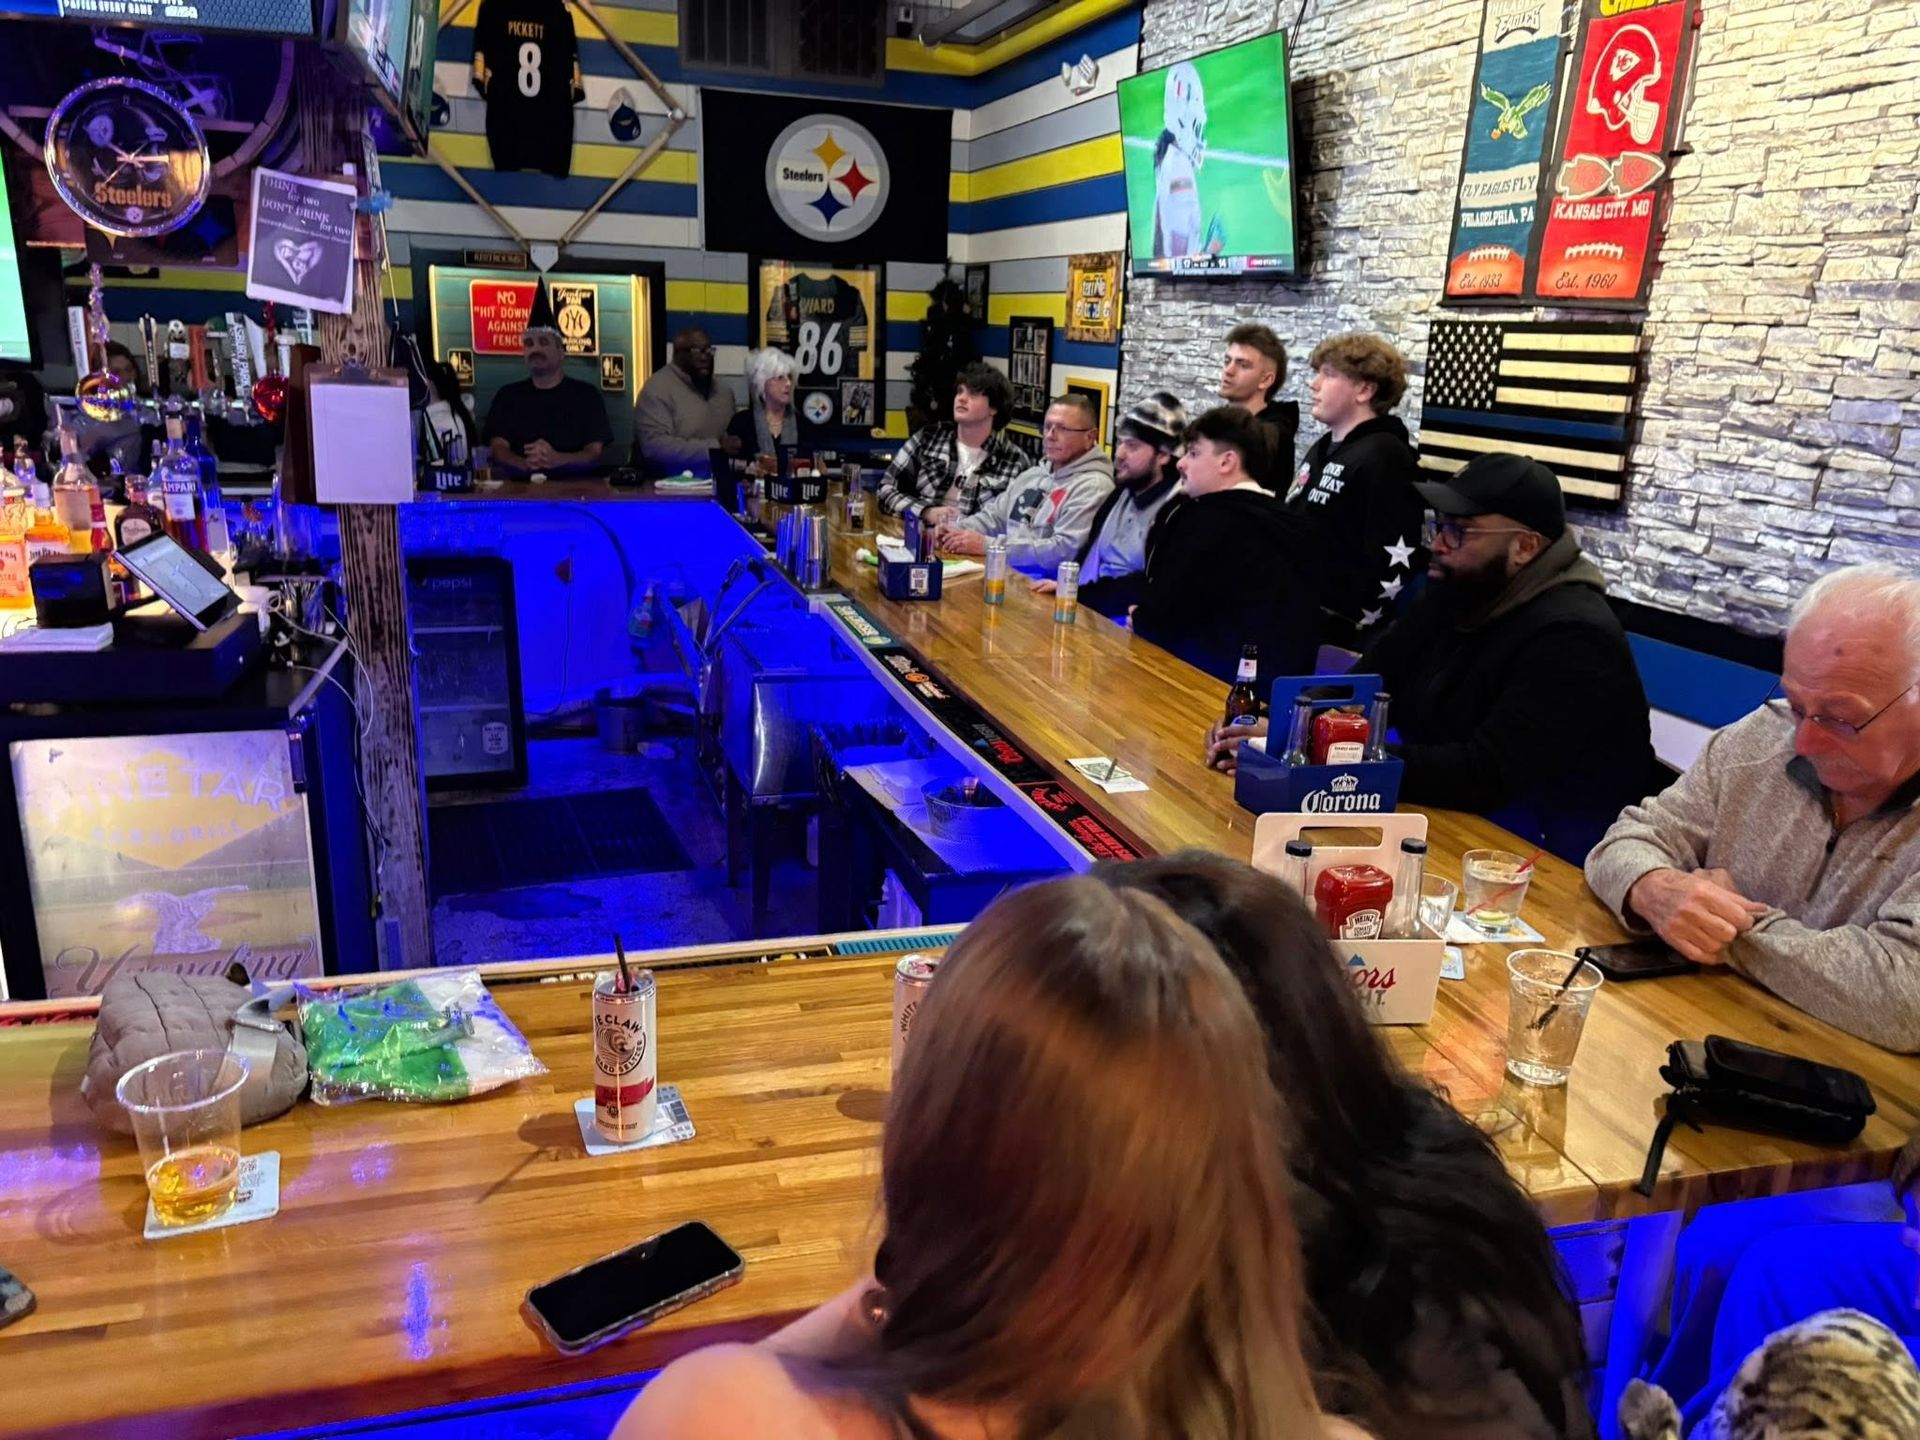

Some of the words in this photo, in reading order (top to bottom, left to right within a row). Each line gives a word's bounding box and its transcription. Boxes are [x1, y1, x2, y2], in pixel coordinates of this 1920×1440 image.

[128, 1, 153, 15] GAME
[507, 20, 545, 40] PICKETT
[517, 41, 542, 98] 8
[261, 174, 298, 193] THINK
[782, 167, 824, 183] Steelers
[94, 182, 173, 208] Steelers
[1461, 183, 1482, 198] FLY
[1480, 179, 1512, 196] EAGLES
[1512, 175, 1537, 193] FLY
[302, 195, 320, 207] two
[1553, 202, 1603, 221] KANSAS
[1630, 199, 1651, 218] MO
[295, 205, 330, 223] DRINK
[1520, 205, 1535, 223] PA
[334, 225, 351, 236] two
[1478, 273, 1503, 289] 1933
[1555, 271, 1579, 290] Est.
[1585, 272, 1618, 289] 1960
[496, 290, 517, 305] NO
[800, 297, 835, 315] WARD
[561, 338, 592, 346] ARKING
[794, 320, 844, 376] 86
[1322, 461, 1345, 478] ONE
[161, 480, 197, 494] AMPARI
[436, 471, 462, 491] Lite
[1318, 474, 1346, 494] WAY
[771, 482, 789, 500] Lite
[802, 484, 821, 501] Lite
[1307, 487, 1331, 506] OUT
[431, 576, 473, 590] pepsi
[1300, 789, 1382, 814] Corona
[1354, 914, 1375, 925] HEINZ
[1353, 966, 1397, 990] ors
